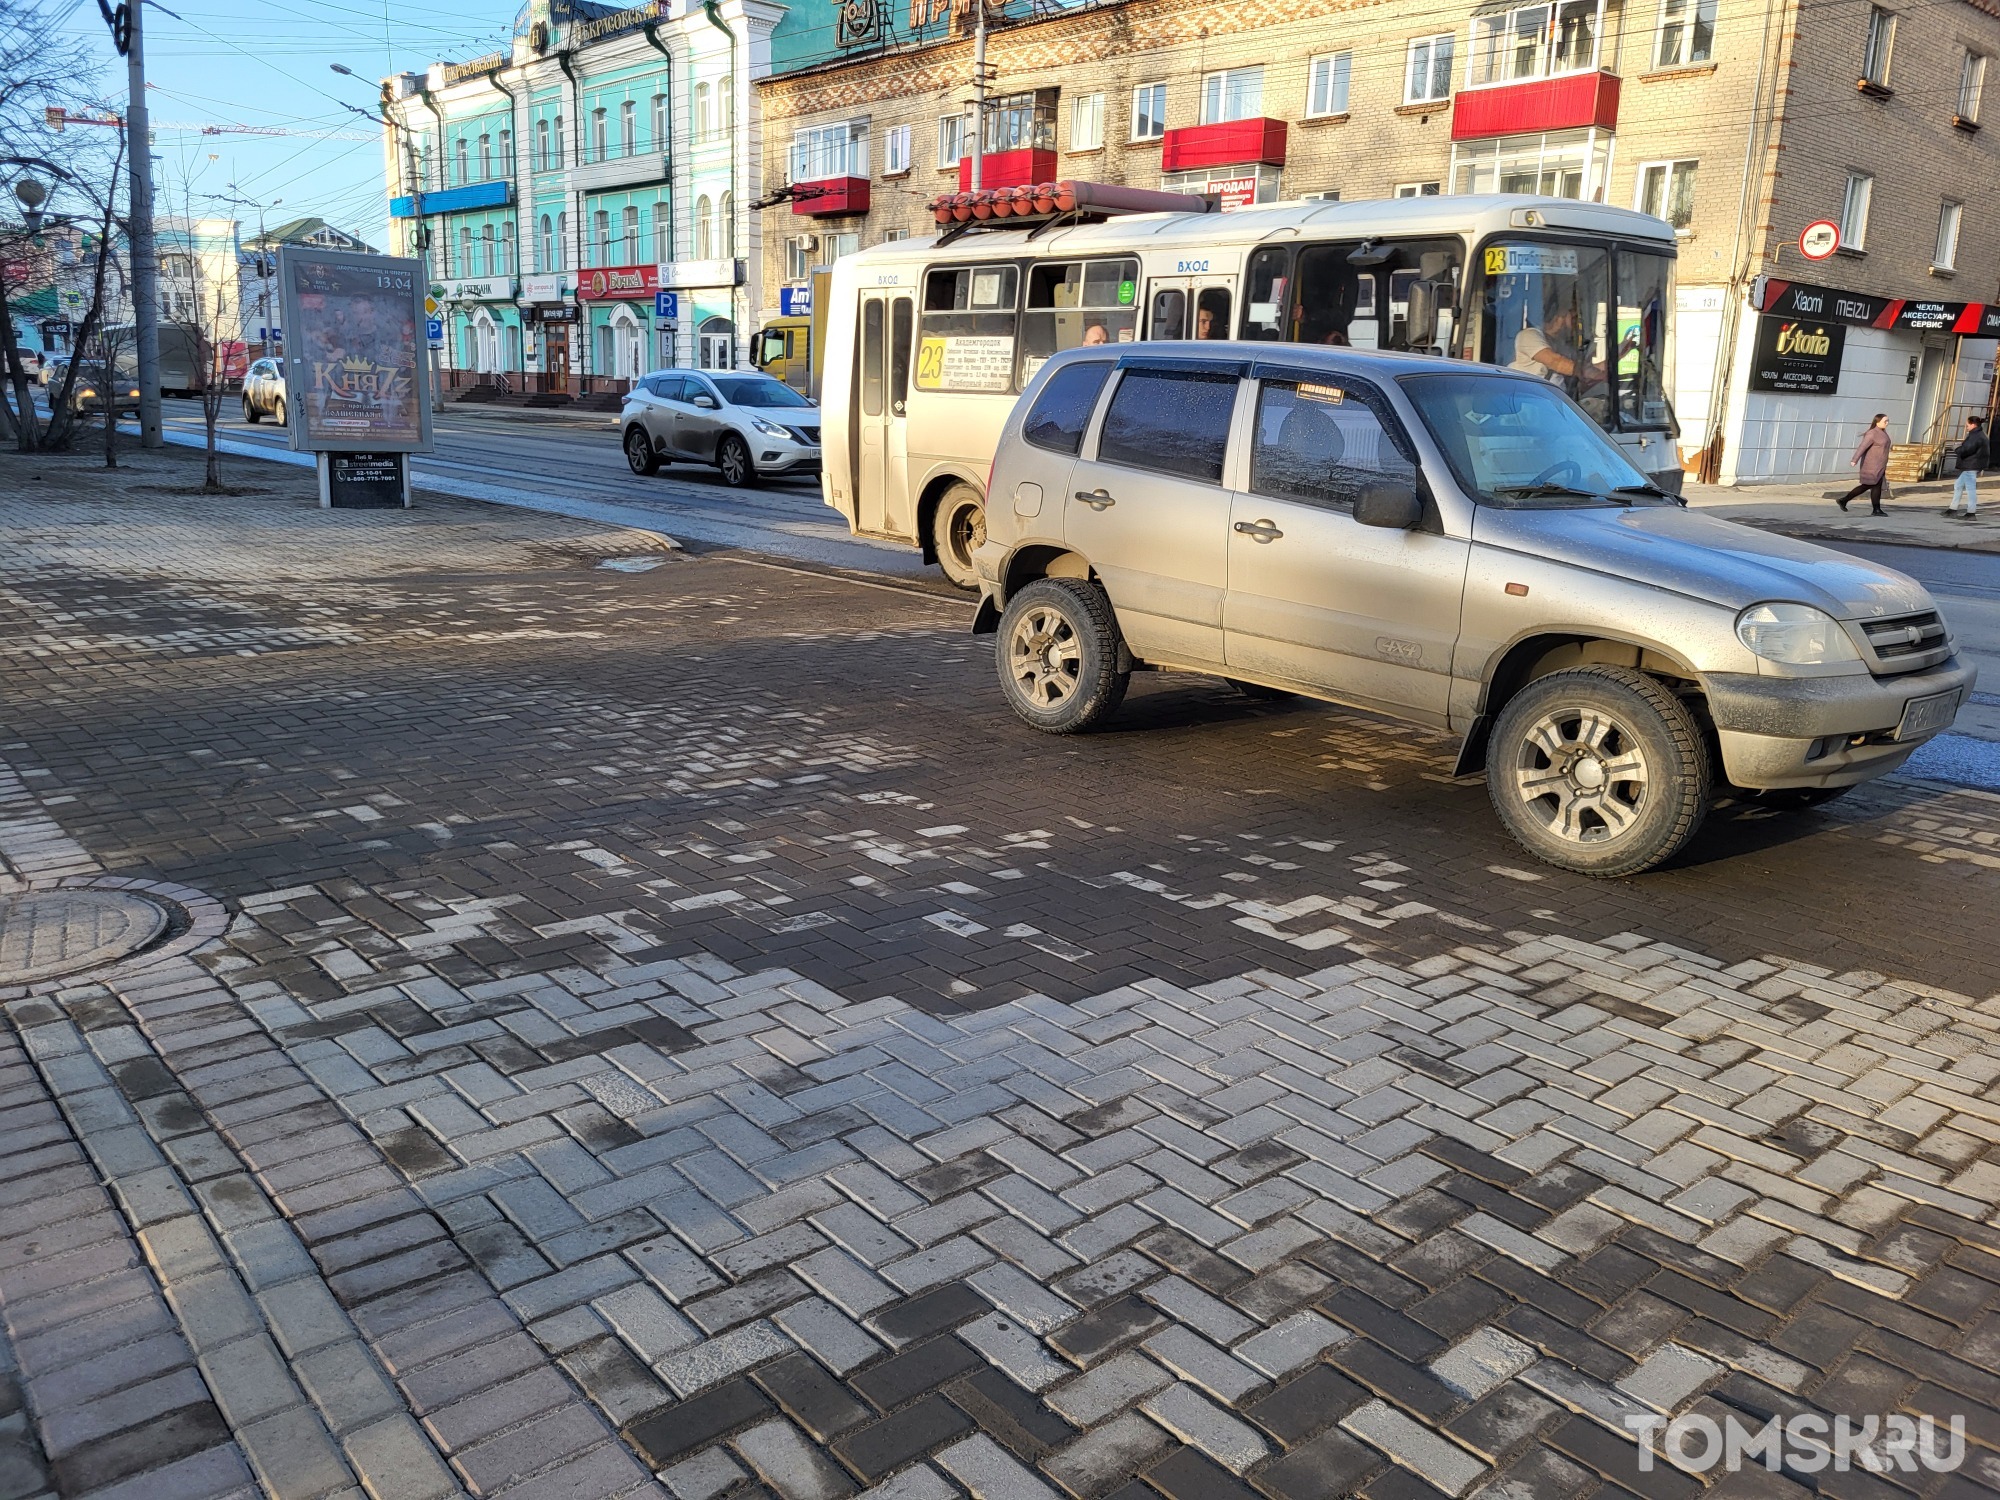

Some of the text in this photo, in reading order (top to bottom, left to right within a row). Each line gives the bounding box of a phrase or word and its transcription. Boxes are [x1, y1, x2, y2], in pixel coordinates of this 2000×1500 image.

[1209, 180, 1254, 194] ПРОДАМ
[1177, 260, 1209, 272] ВХОД
[1487, 250, 1506, 272] 23
[377, 276, 411, 290] 13.04
[878, 275, 898, 285] ВХОД
[464, 283, 493, 295] СБЕРБАНК
[661, 295, 673, 314] P
[1703, 298, 1717, 308] 131
[1792, 289, 1871, 320] Xiaomi MEIZU
[1916, 303, 1944, 312] ЧЕХЛЫ
[1902, 312, 1955, 321] АКСЕССУАРЫ
[428, 322, 439, 337] P
[1911, 320, 1943, 329] СЕРВИС
[920, 346, 944, 378] 23
